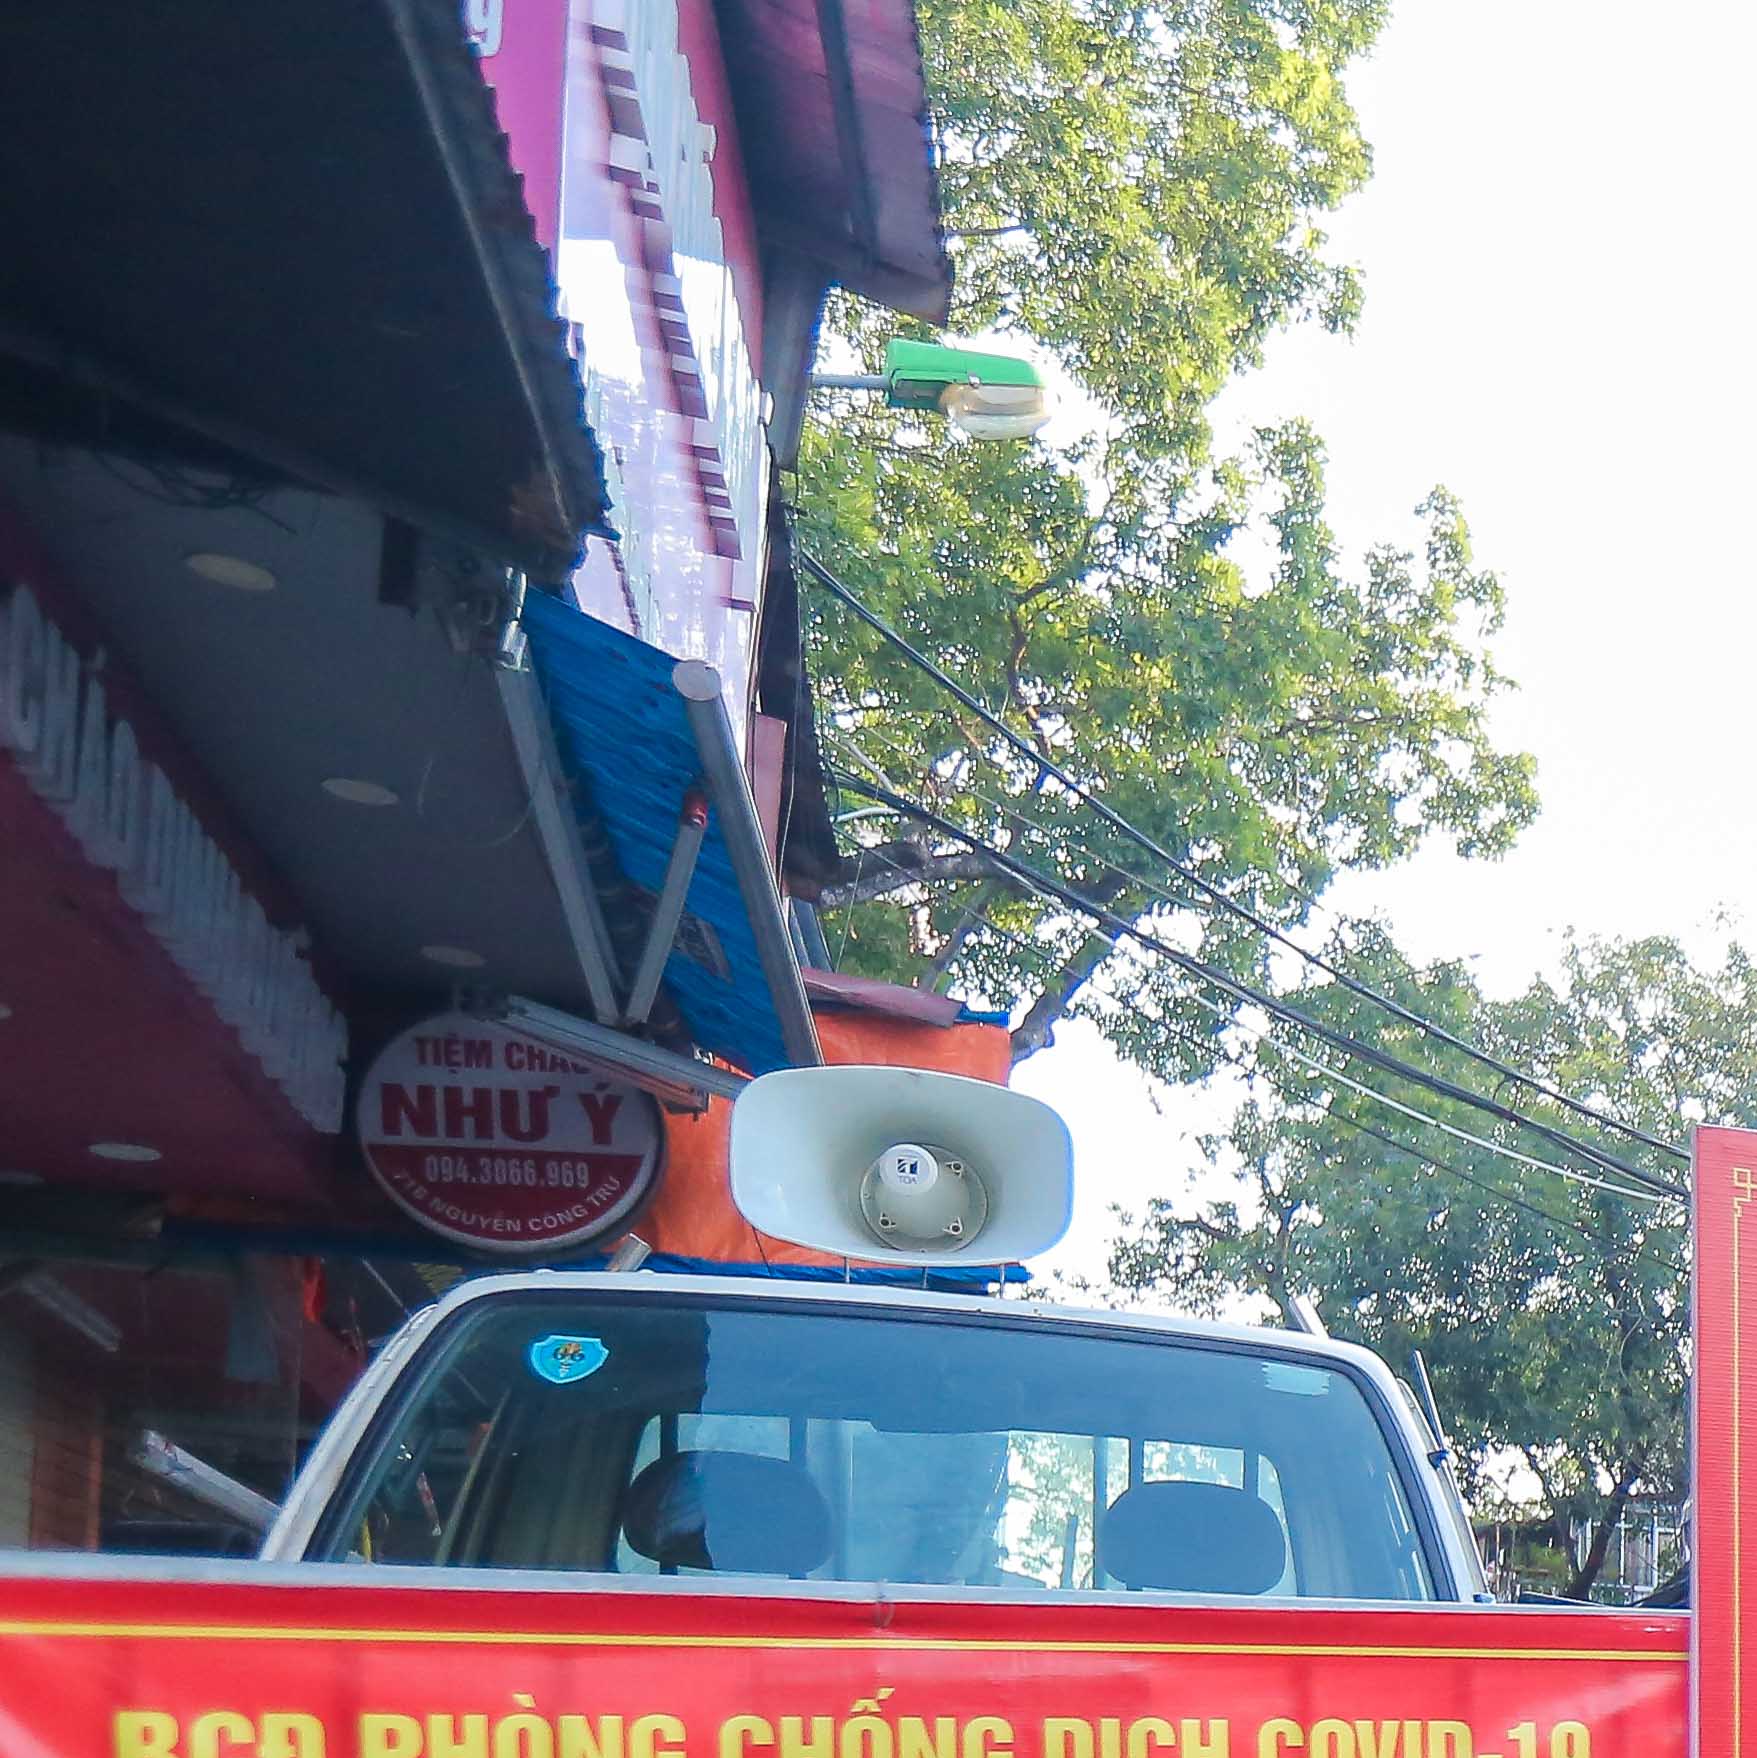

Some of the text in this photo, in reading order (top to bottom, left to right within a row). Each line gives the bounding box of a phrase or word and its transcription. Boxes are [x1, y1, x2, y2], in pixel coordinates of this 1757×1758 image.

[415, 1033, 492, 1073] TIỆM
[381, 1082, 624, 1145] NHƯ Ý
